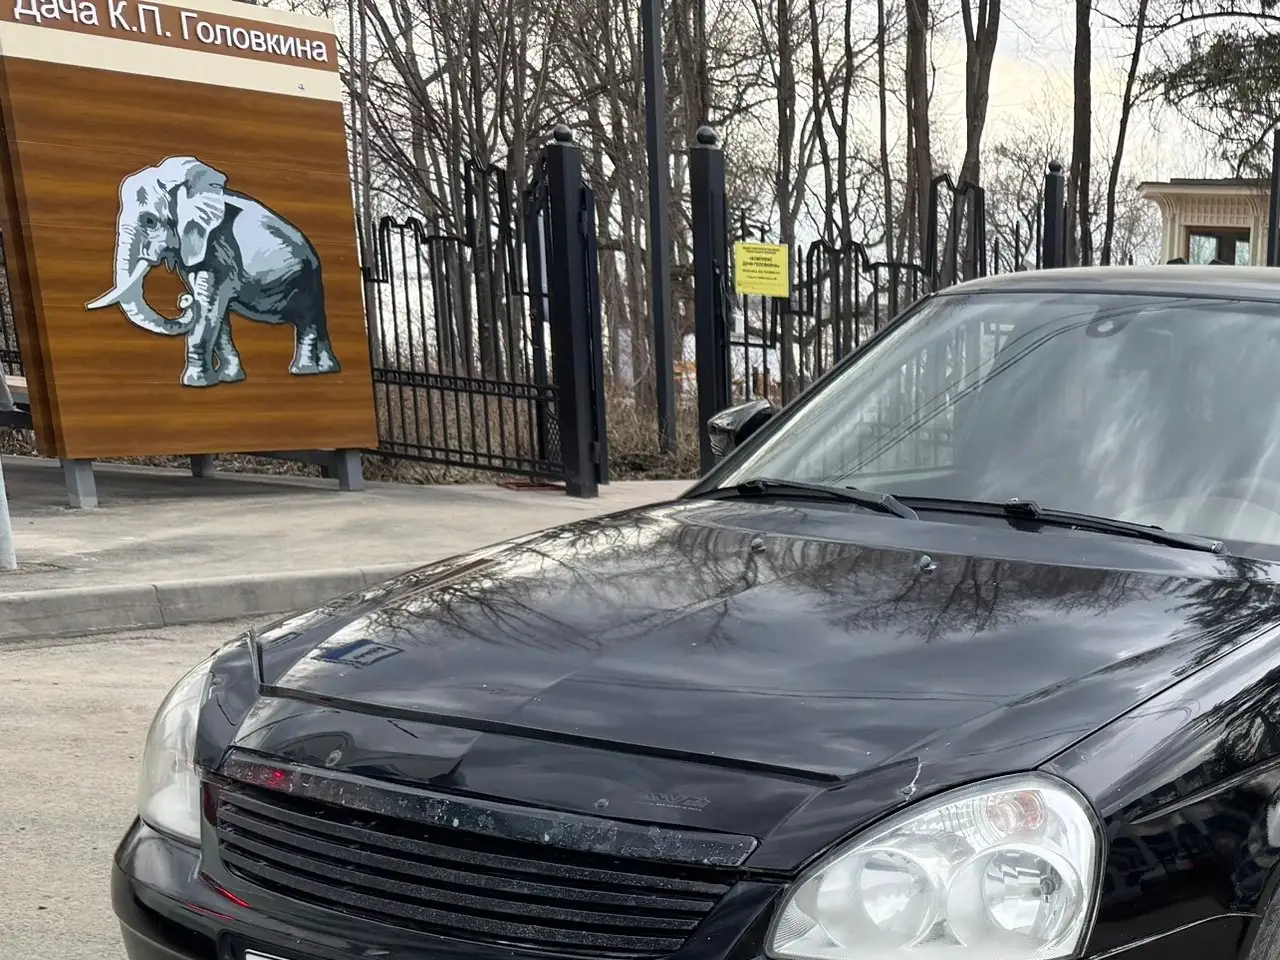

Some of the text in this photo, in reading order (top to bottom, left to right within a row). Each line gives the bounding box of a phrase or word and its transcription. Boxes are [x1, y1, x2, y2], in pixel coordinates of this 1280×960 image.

[13, 0, 328, 62] Дача К.П. Головкина
